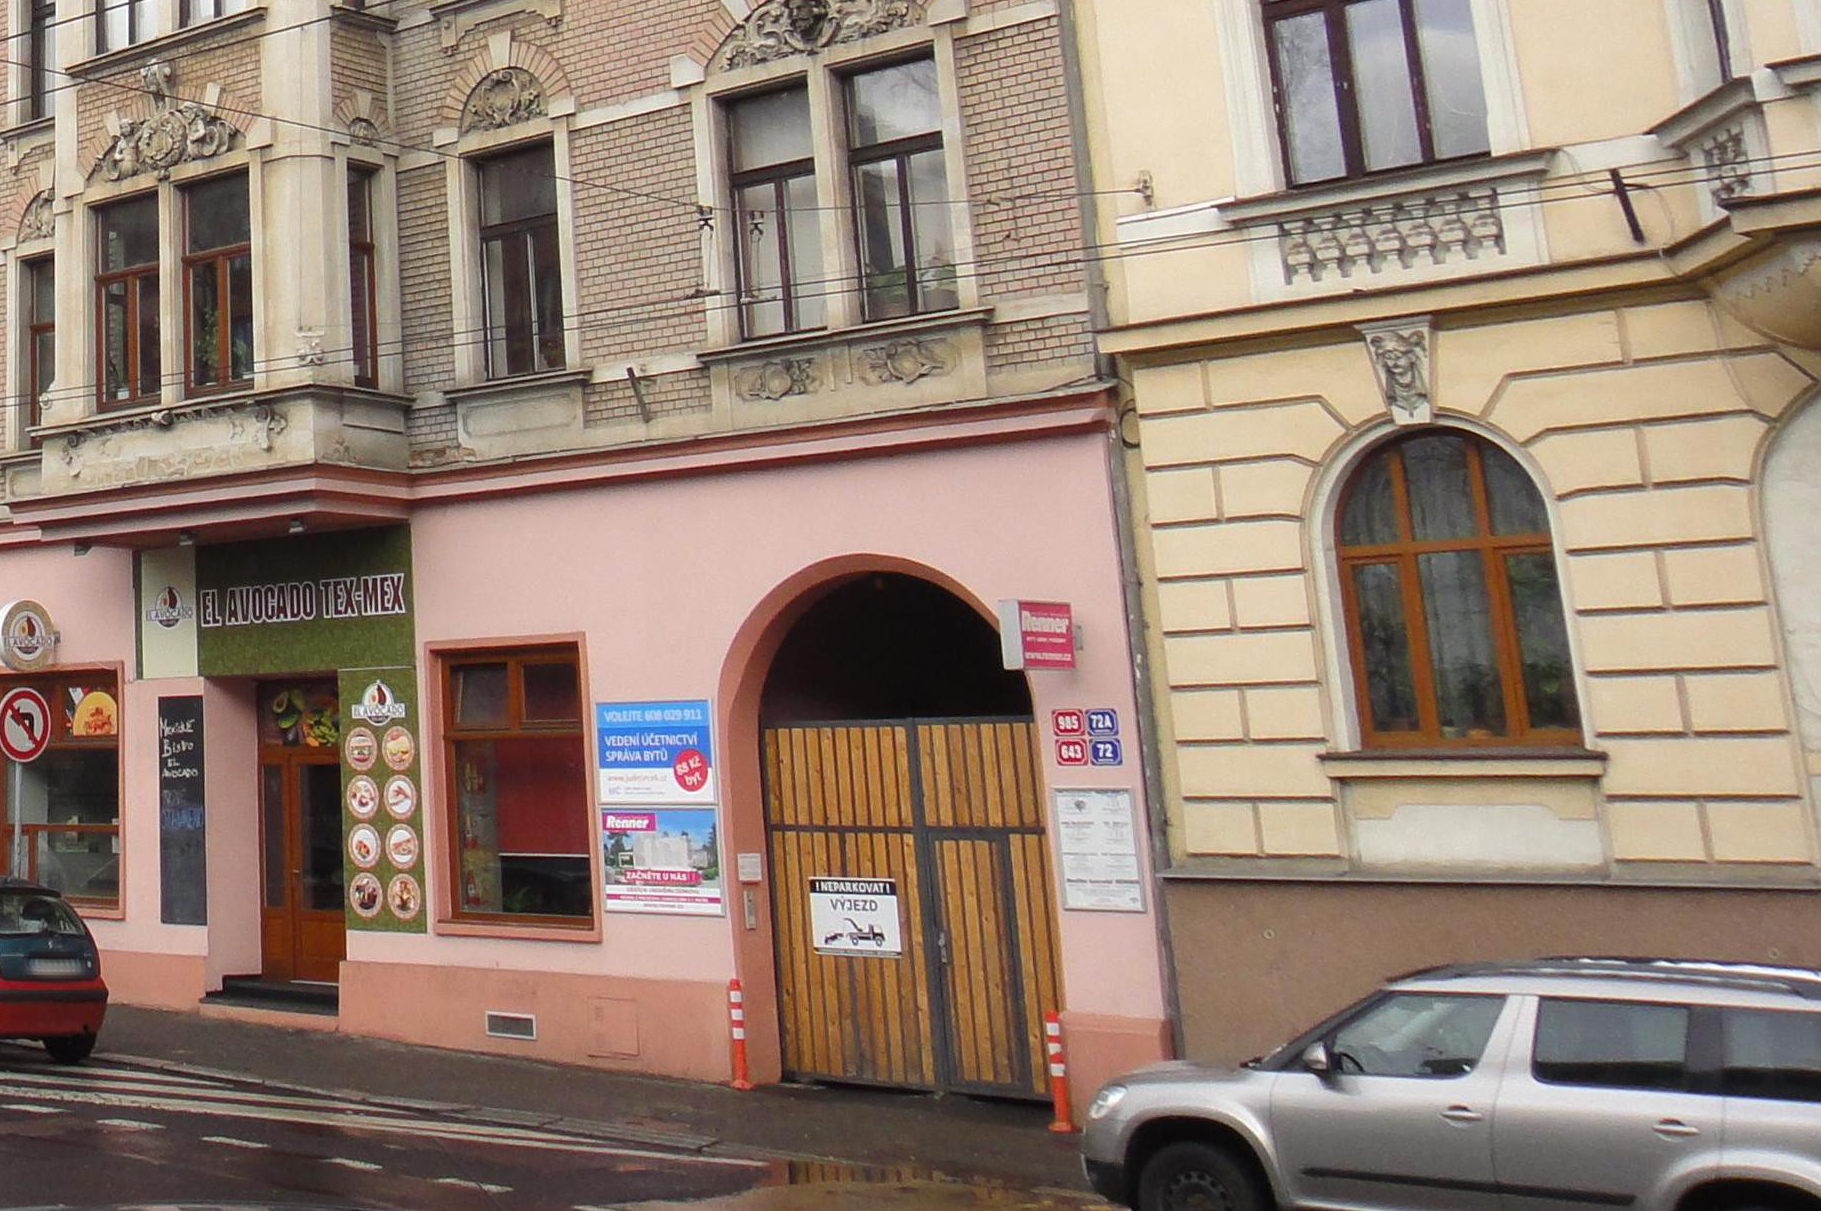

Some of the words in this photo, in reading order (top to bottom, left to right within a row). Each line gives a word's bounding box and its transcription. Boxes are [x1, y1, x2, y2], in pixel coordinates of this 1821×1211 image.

[201, 589, 222, 627] EL
[226, 582, 315, 625] AVOCADO
[320, 573, 405, 618] TEX-MEX
[1021, 610, 1069, 634] Renner
[604, 710, 643, 722] VOLEJTE
[684, 709, 701, 720] 911
[1057, 715, 1079, 730] 985
[1090, 714, 1113, 729] 72A
[605, 733, 639, 746] VEDENÍ
[641, 731, 698, 746] ÚČETNICTVÍ
[605, 749, 642, 762] SPRÁVA
[644, 748, 668, 761] BYTŮ
[1061, 745, 1082, 759] 643
[1096, 743, 1114, 758] 72
[684, 772, 701, 786] byt
[606, 815, 649, 828] Renner
[821, 881, 885, 893] NEPARKOVAT
[830, 895, 878, 911] VÝJEZD
